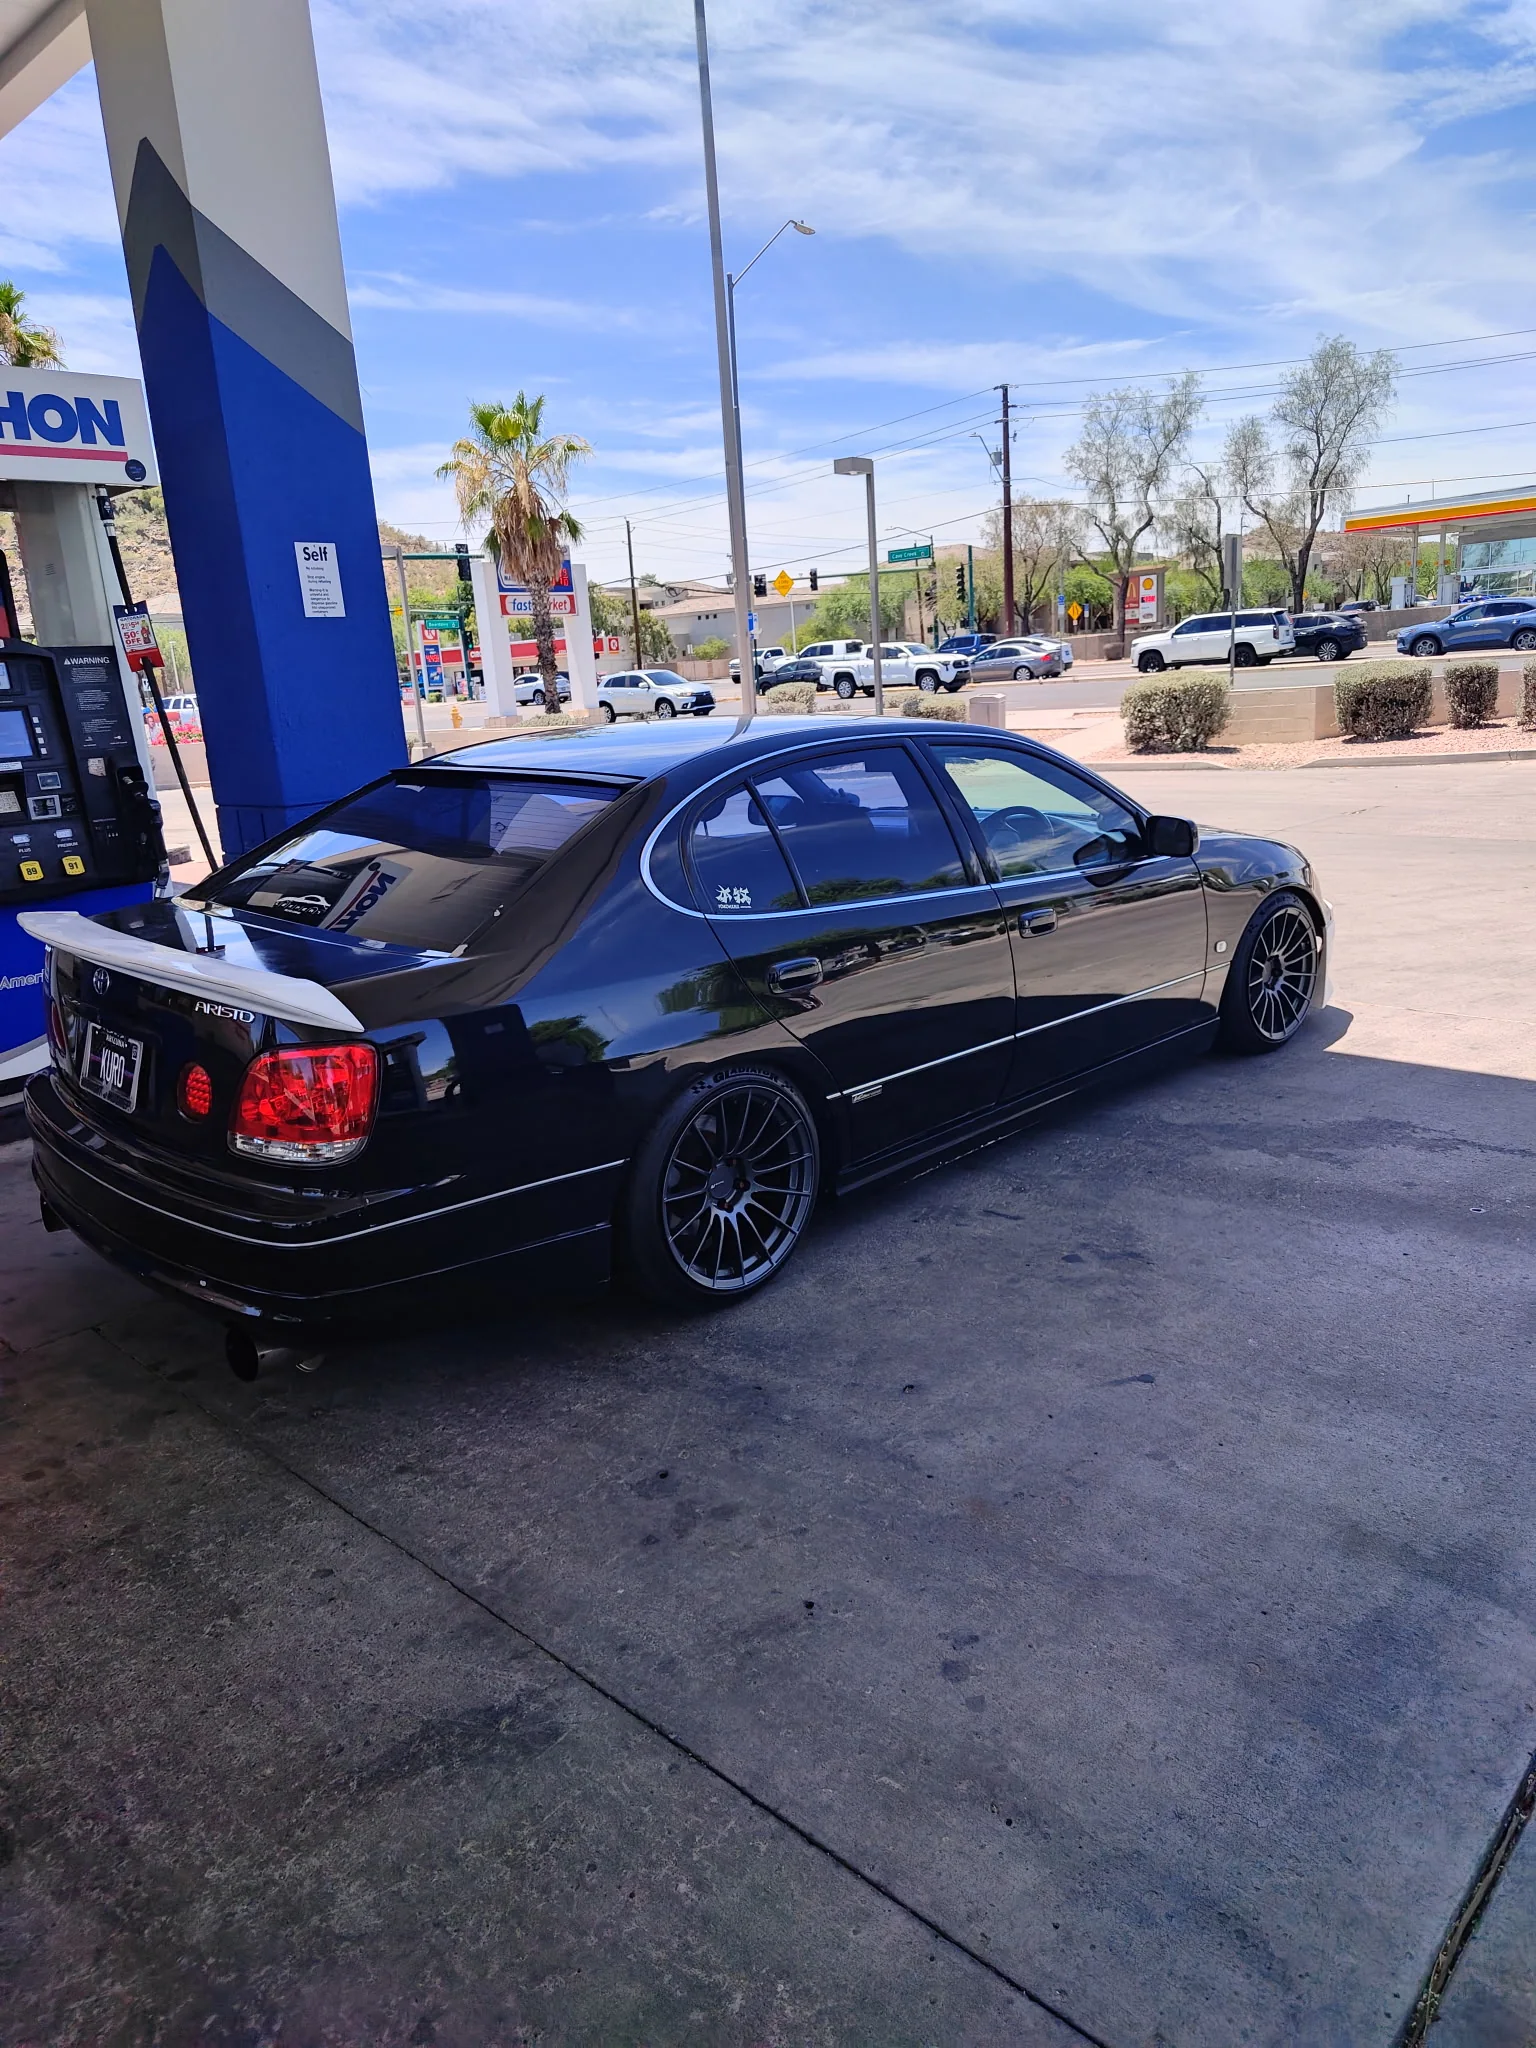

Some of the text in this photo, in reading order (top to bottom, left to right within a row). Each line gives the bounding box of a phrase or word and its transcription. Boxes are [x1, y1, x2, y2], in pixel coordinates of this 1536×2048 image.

[303, 546, 328, 561] Self
[512, 598, 532, 611] fast
[70, 657, 110, 665] WARNING
[26, 867, 38, 875] 89
[68, 862, 79, 870] 91
[195, 1001, 256, 1023] ARISTO
[105, 1034, 125, 1048] ARIZONA
[100, 1047, 125, 1088] KURO
[712, 1068, 779, 1084] GLADIATOR
